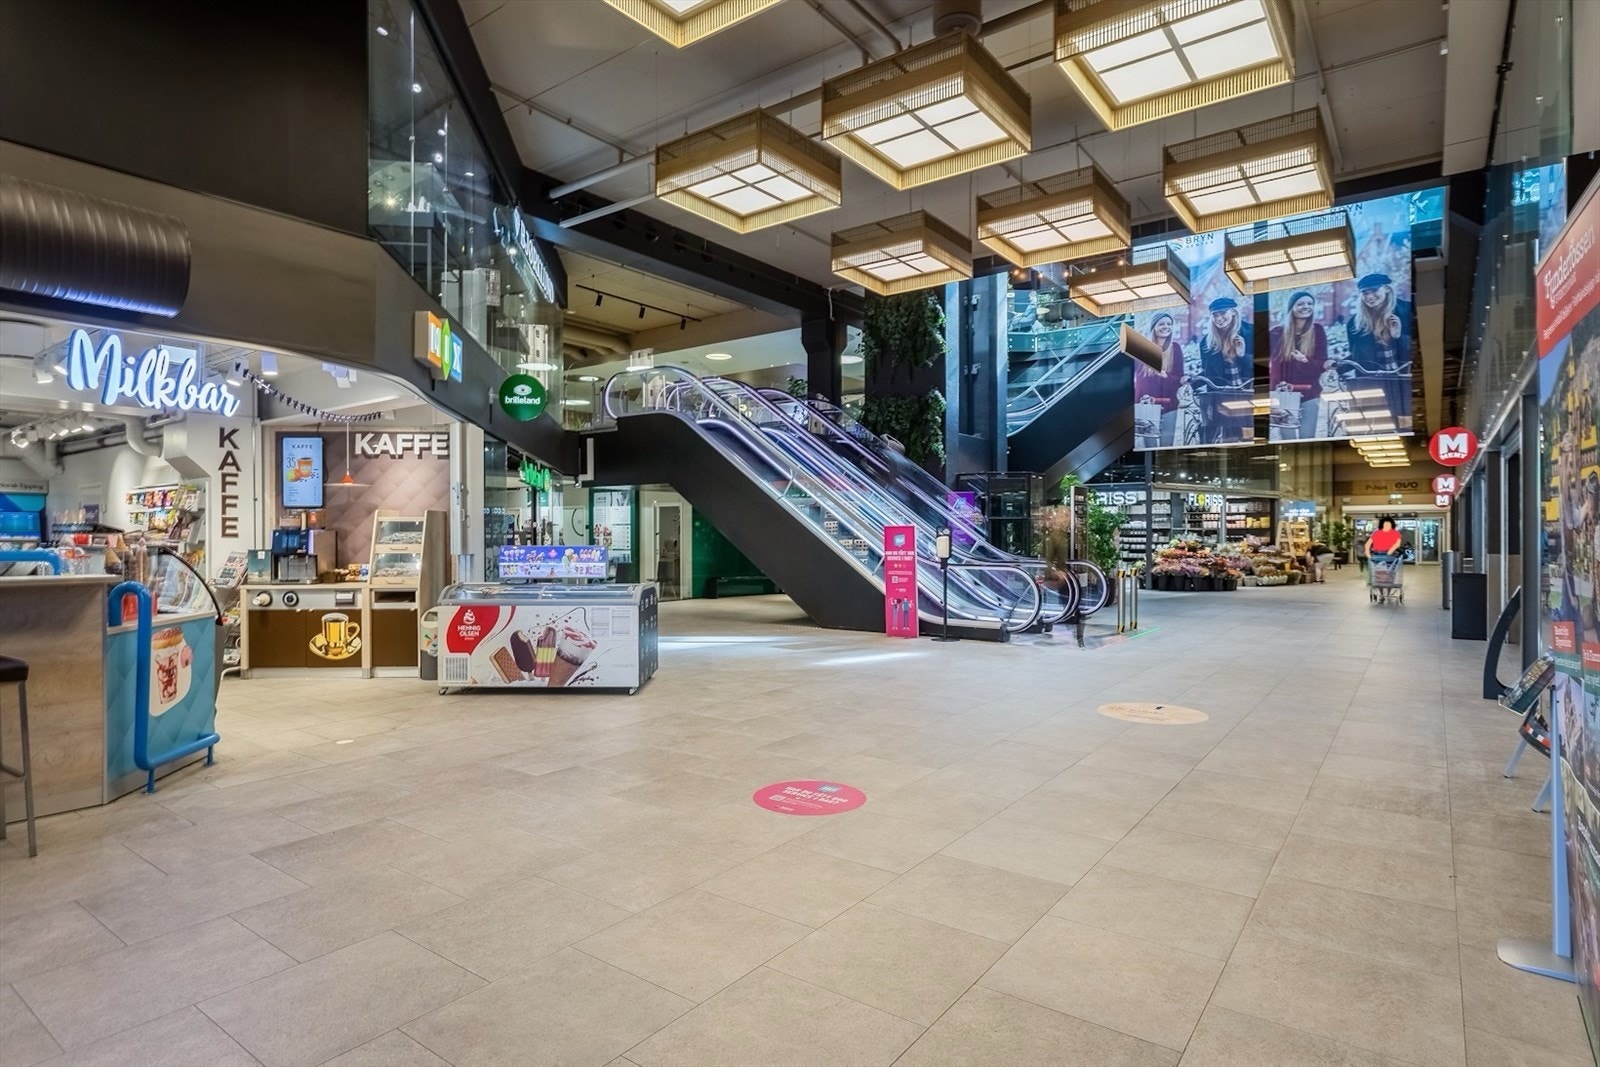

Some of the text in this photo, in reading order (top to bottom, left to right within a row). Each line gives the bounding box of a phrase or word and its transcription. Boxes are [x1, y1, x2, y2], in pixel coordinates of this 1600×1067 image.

[1186, 232, 1214, 244] BRYN
[428, 322, 462, 374] MIX
[67, 329, 241, 417] Milkbar
[504, 395, 541, 405] brilleland
[355, 433, 450, 456] KAFFE
[1439, 452, 1468, 461] MENY
[218, 427, 242, 538] KAFFE
[1094, 490, 1138, 506] RISS
[1188, 492, 1224, 507] FLORISS
